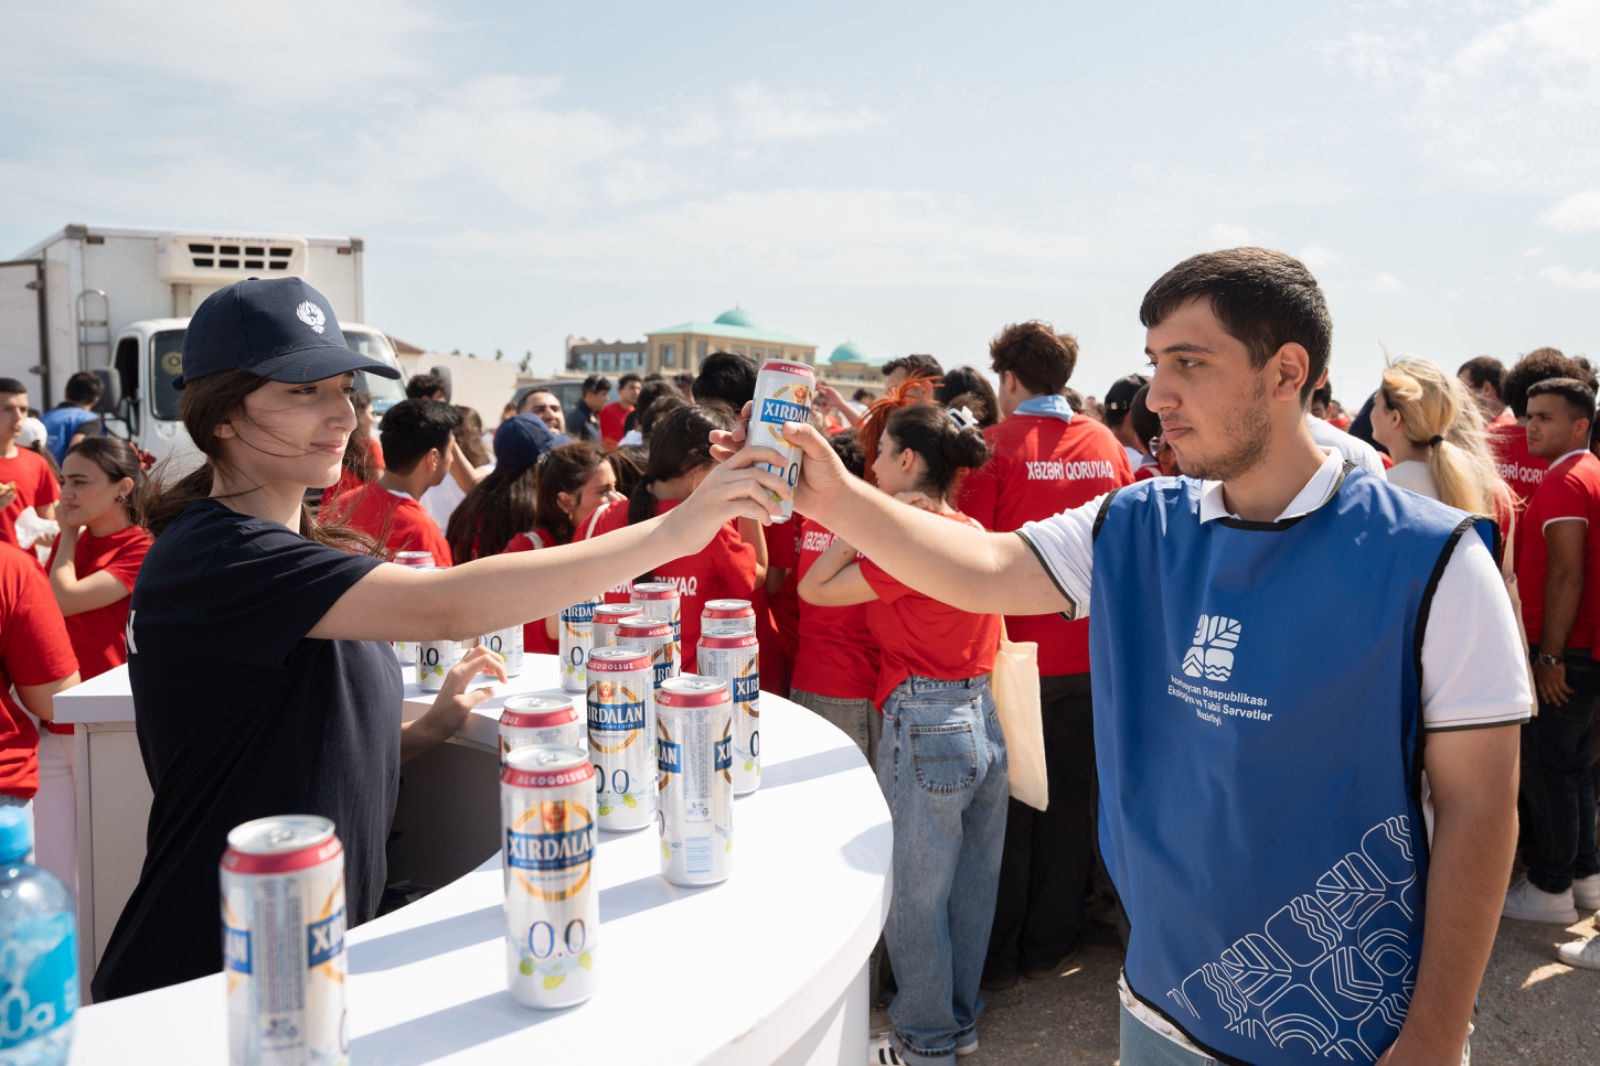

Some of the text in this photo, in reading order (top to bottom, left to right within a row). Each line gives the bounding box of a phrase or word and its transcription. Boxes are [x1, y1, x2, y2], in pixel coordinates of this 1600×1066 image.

[1065, 460, 1115, 480] QORUYAQ
[1202, 686, 1268, 707] Respublikası
[1222, 703, 1274, 722] Sərvətlər
[517, 768, 589, 785] ALKOQOLSUZ
[527, 918, 587, 960] 0.0
